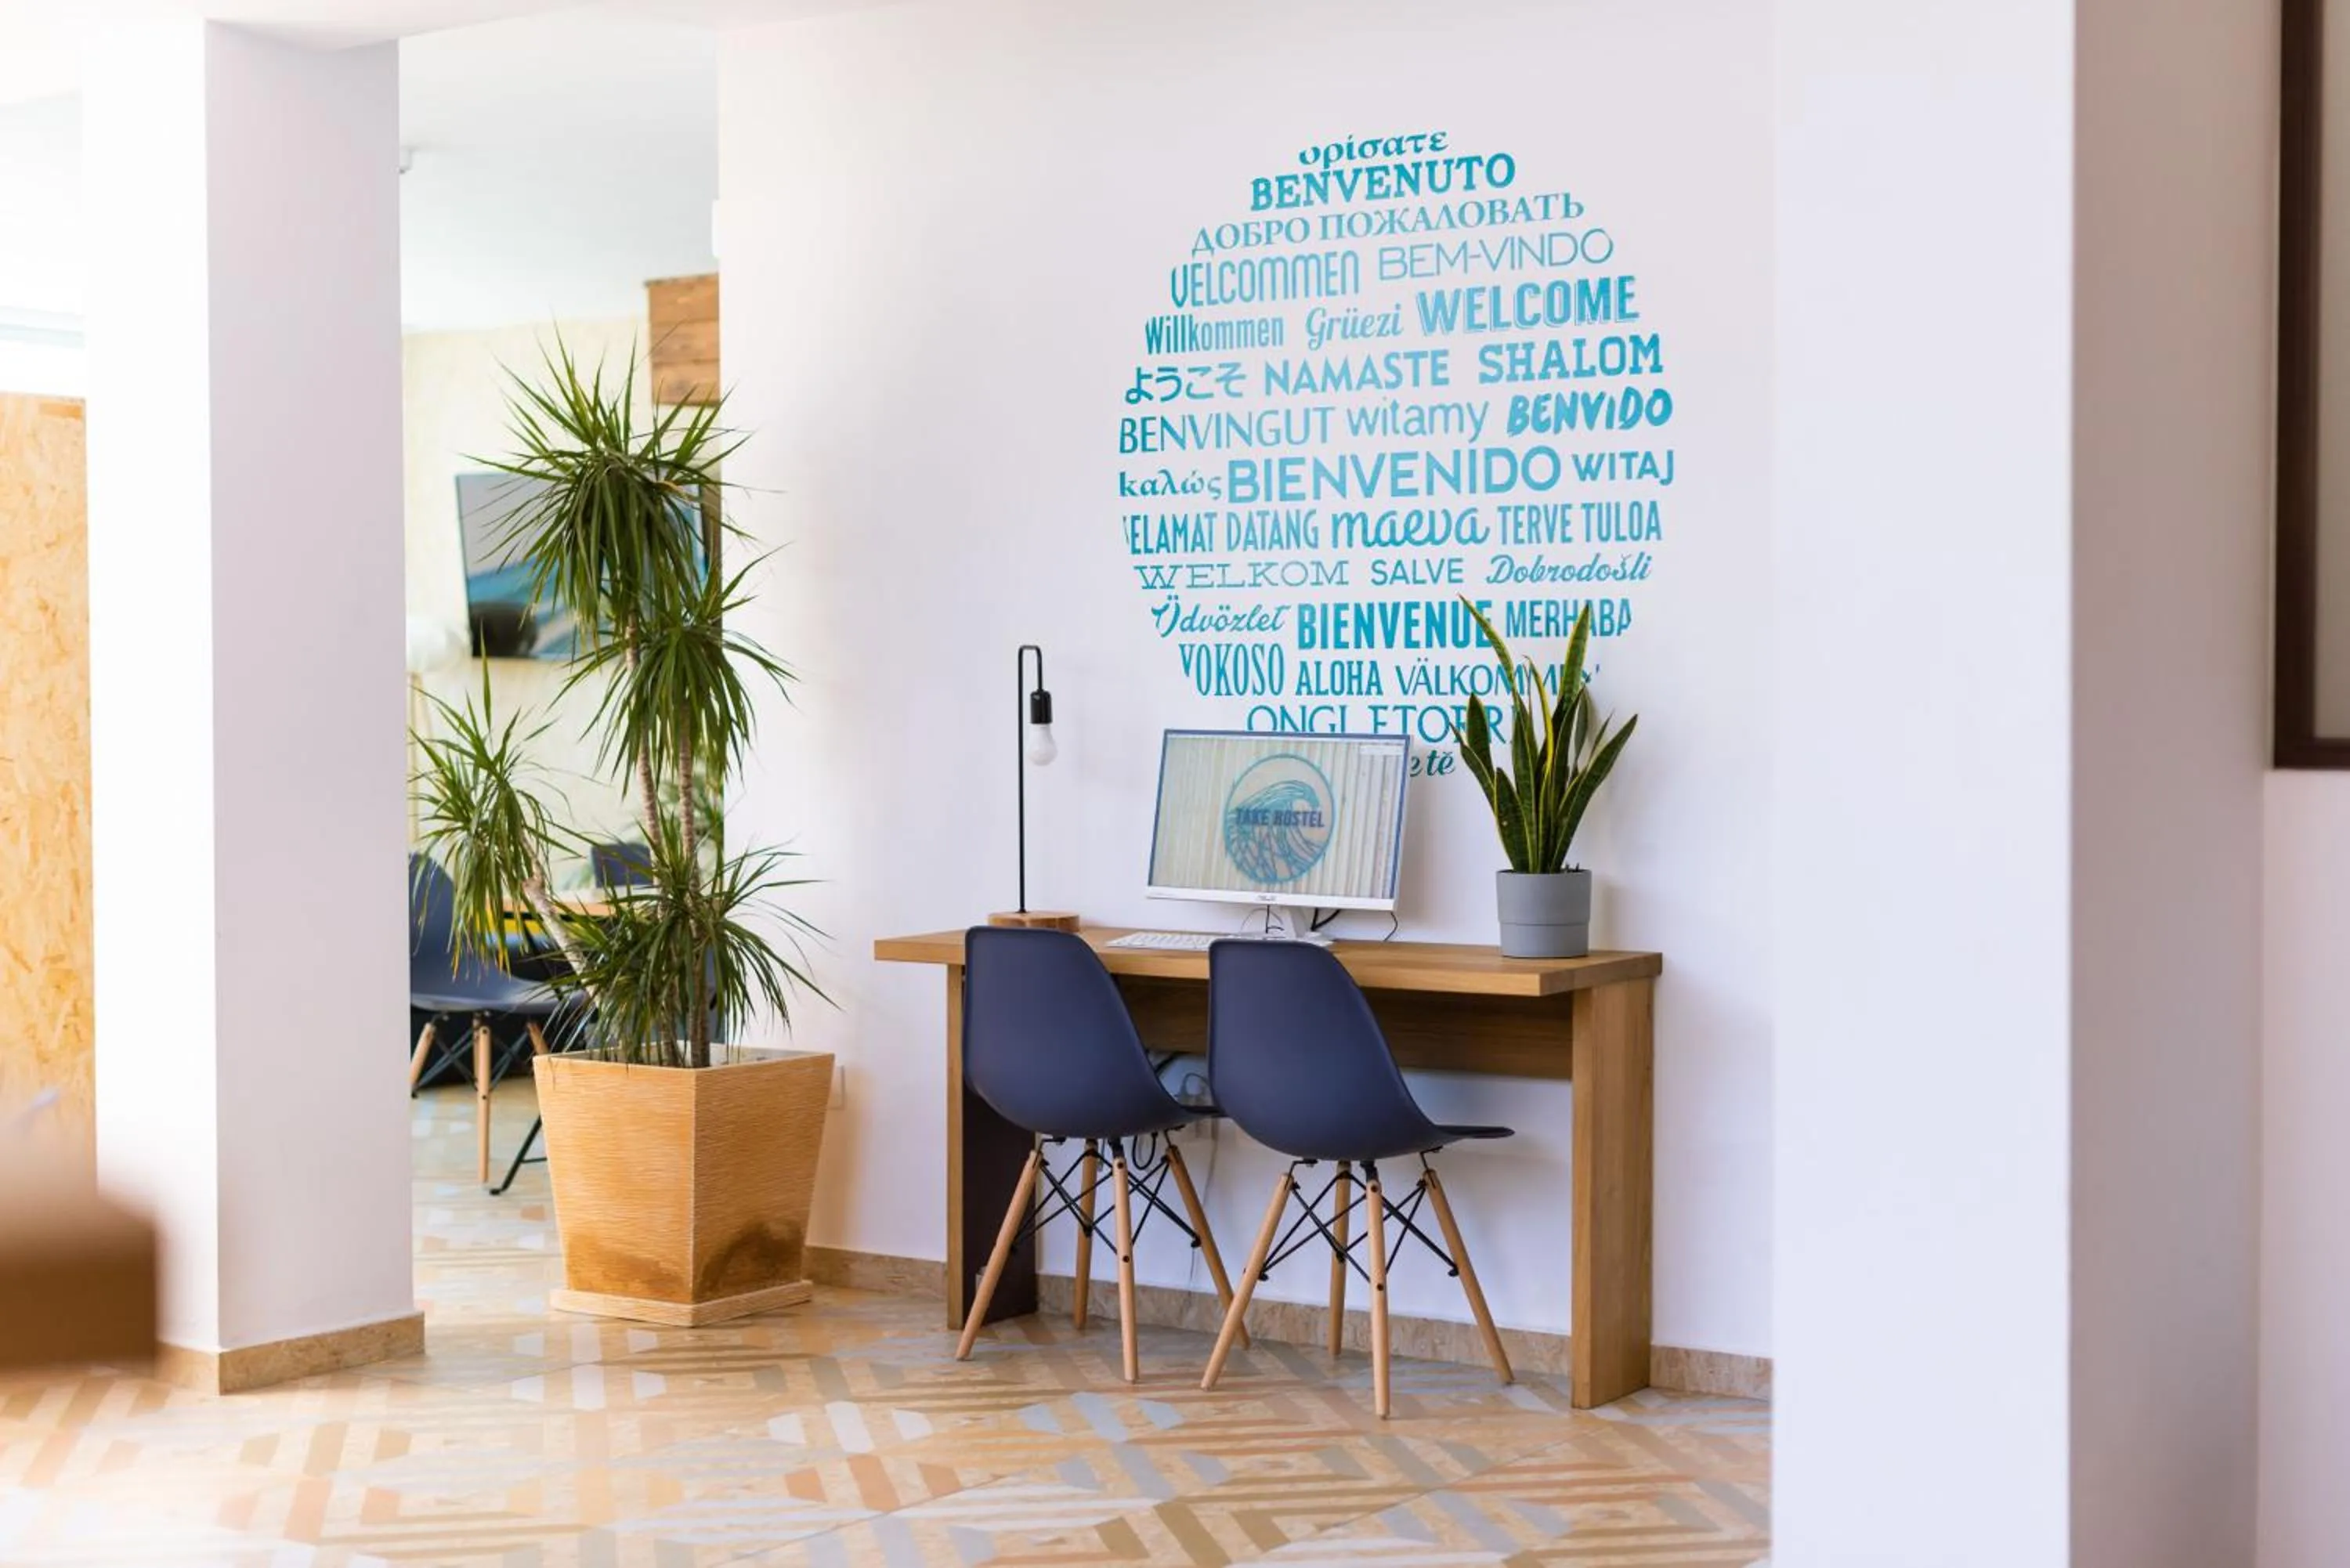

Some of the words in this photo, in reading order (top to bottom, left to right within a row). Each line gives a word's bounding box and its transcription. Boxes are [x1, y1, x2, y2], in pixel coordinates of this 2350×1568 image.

[1251, 153, 1516, 211] BENVENUTO
[1191, 218, 1310, 258] ДОБРО
[1319, 192, 1585, 240] ПОЖАЛОВАТЬ
[1379, 228, 1614, 280] BEM-VINDO
[1144, 313, 1284, 356] Willkommen
[1305, 303, 1402, 351] Grüezi
[1416, 275, 1640, 336] WELCOME
[1124, 362, 1247, 405] ようこそ
[1264, 349, 1450, 397] NAMASTE
[1479, 332, 1664, 385] SHALOM
[1119, 406, 1335, 455] BENVINGUT
[1347, 399, 1489, 443] witamy
[1506, 385, 1673, 437] BENVIDO
[1227, 445, 1561, 504] BIENVENIDO
[1571, 450, 1674, 486] WITAJ
[1123, 511, 1217, 556] ELAMAT
[1227, 508, 1319, 552] DATANG
[1331, 507, 1491, 550] maeva
[1497, 503, 1574, 546] TERVE
[1580, 500, 1662, 544] TULOA
[1133, 560, 1349, 590] WELKOM
[1371, 558, 1464, 587] SALVE
[1484, 551, 1652, 584] Dobrodošli
[1151, 594, 1291, 638] Üdvözlet
[1297, 599, 1493, 651] BIENVENUE
[1506, 598, 1632, 638] MERHABA
[1295, 659, 1383, 696] ALOHA
[1395, 657, 1600, 696] VÄLKOMM
